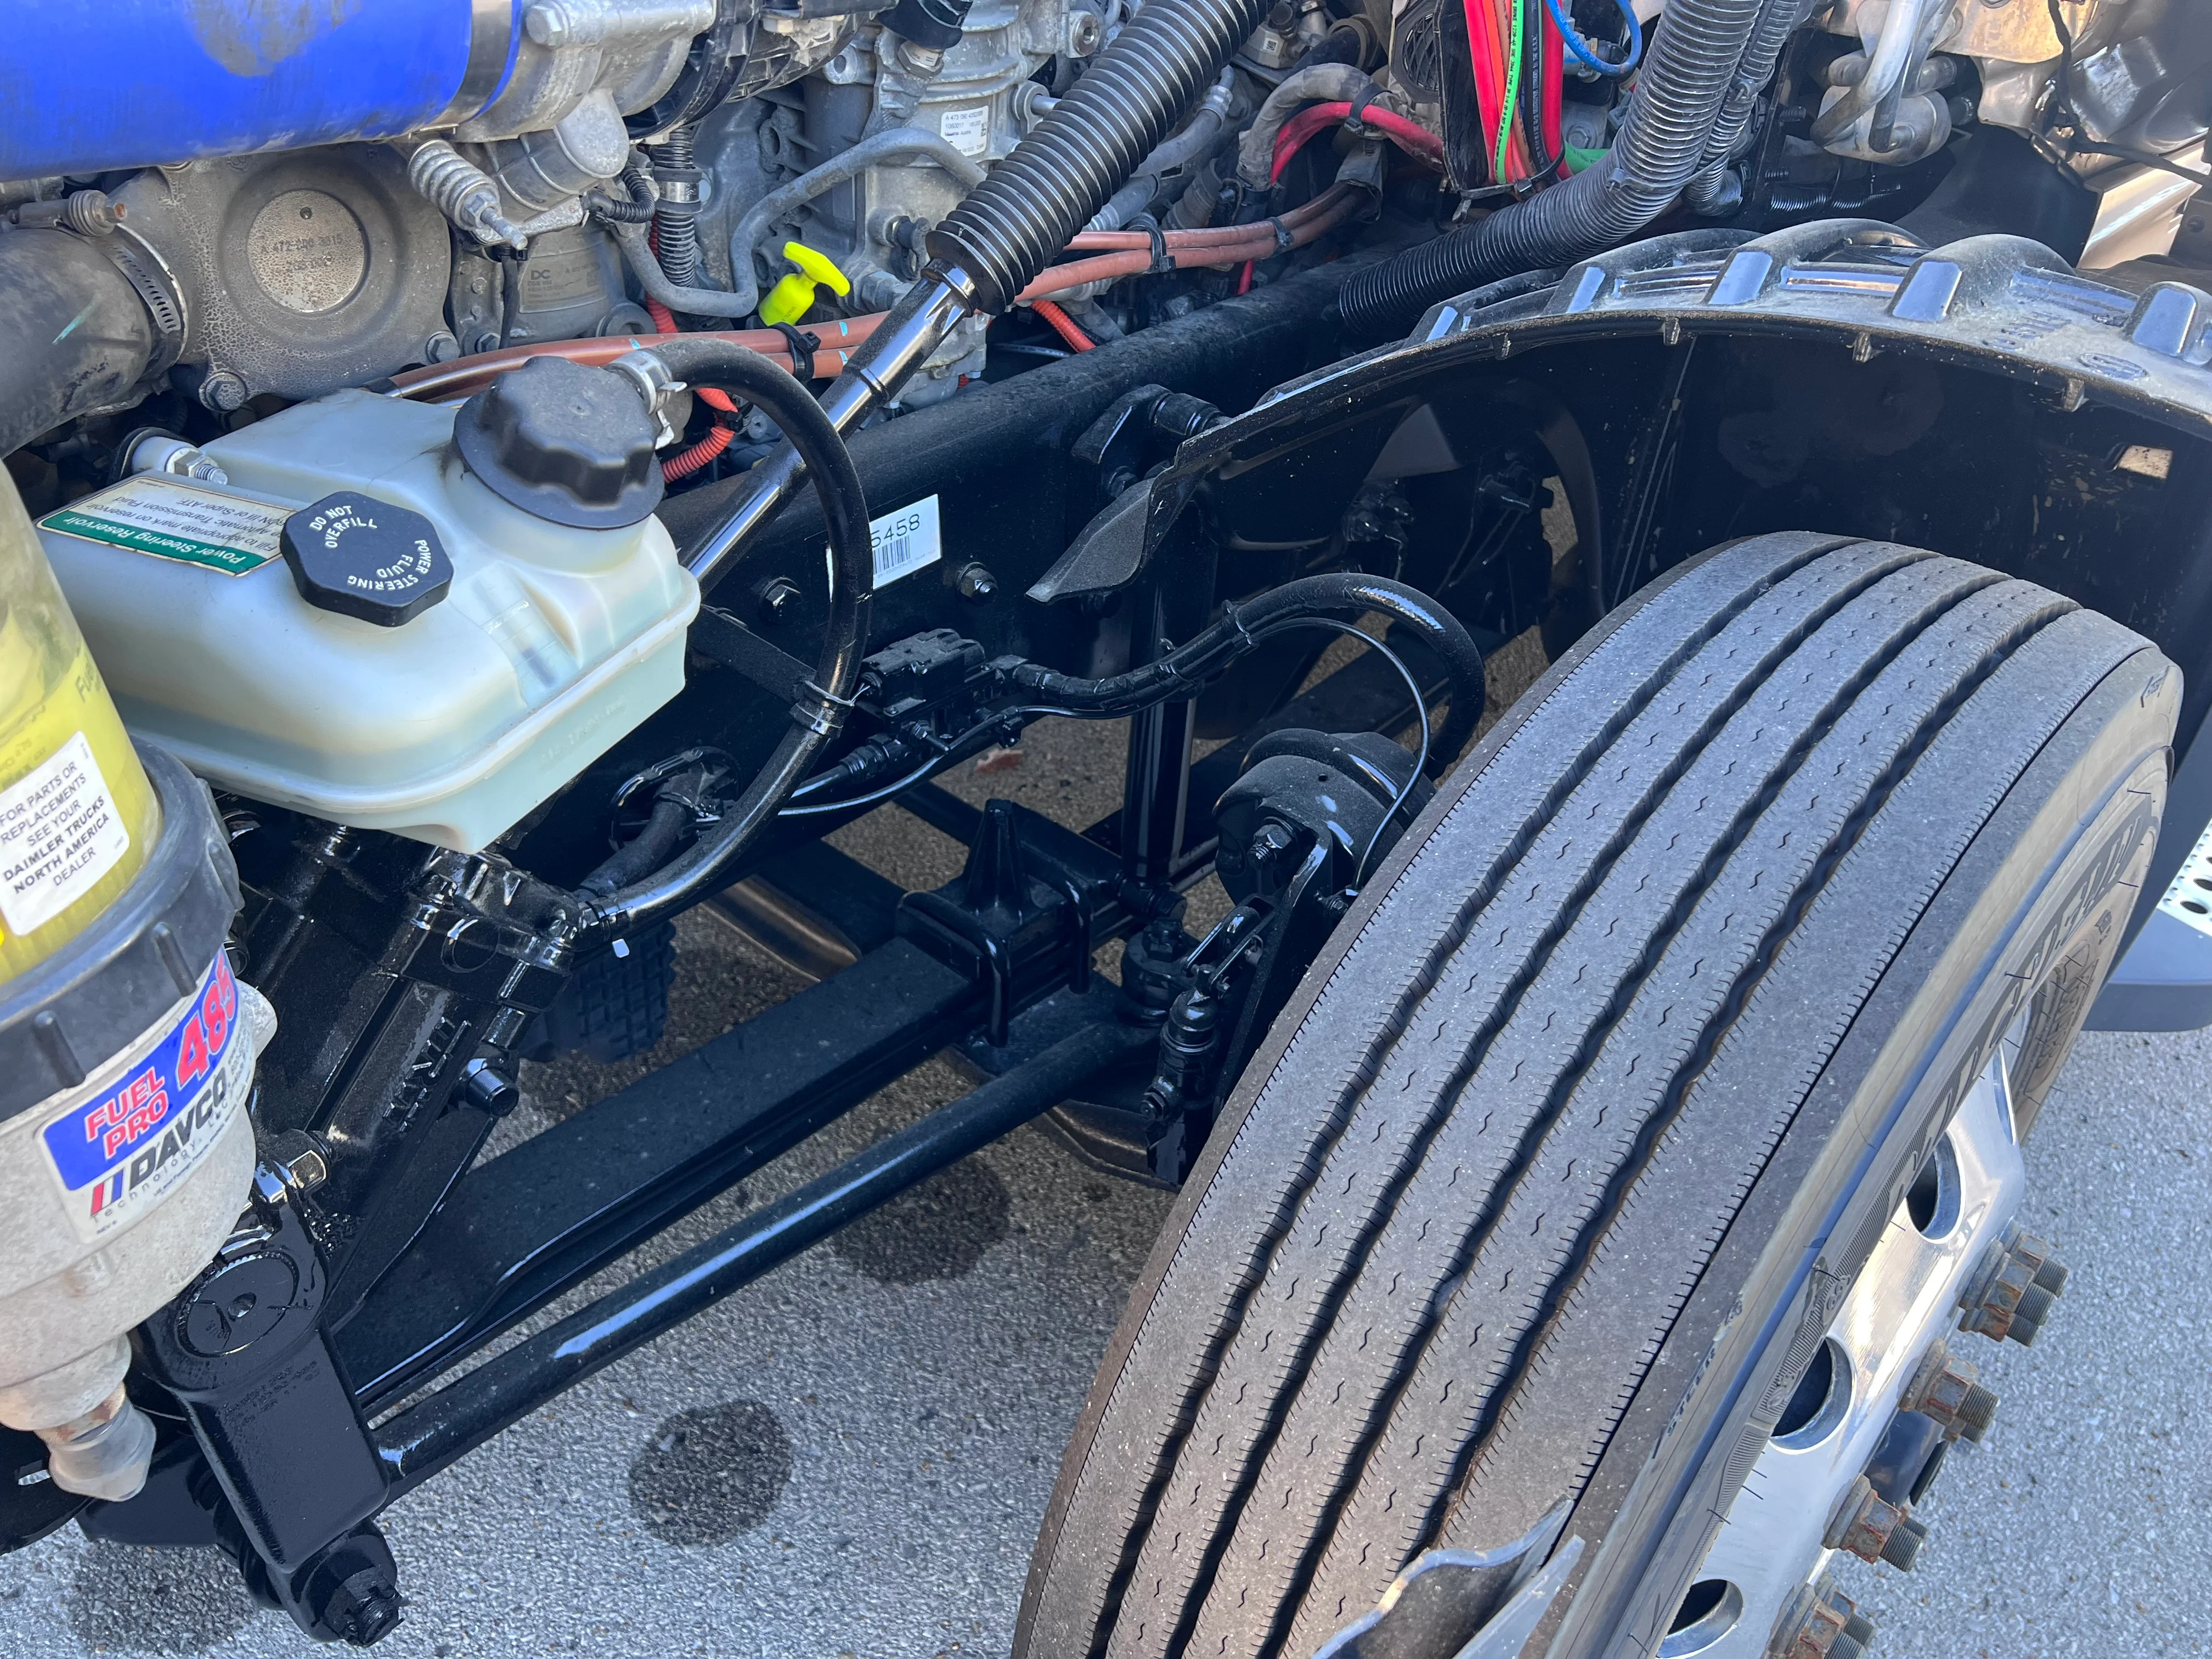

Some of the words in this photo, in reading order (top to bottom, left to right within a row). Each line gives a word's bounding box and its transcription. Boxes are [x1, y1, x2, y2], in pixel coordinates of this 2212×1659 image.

[531, 269, 551, 280] DC
[112, 496, 144, 507] Fluid
[143, 501, 214, 523] Transmission
[201, 503, 235, 515] Super
[63, 517, 136, 538] Reservoir
[151, 518, 182, 528] mark
[214, 519, 269, 535] Automatic
[308, 516, 327, 532] DO
[324, 505, 353, 520] NOT
[133, 531, 198, 553] Steering
[181, 525, 246, 541] appropriate
[324, 517, 379, 549] OVERFILL
[195, 548, 247, 565] Power
[257, 543, 278, 551] Fill
[413, 539, 432, 575] POWER
[376, 554, 414, 579] FLUID
[347, 574, 419, 591] STEERING
[0, 803, 27, 826] FOR
[27, 775, 63, 809] PARTS
[63, 760, 78, 778] OR
[1, 773, 87, 845] REPLACEMENTS
[26, 823, 52, 847] SEE
[50, 799, 82, 828] YOUR
[4, 833, 65, 882] DAIMLER
[65, 795, 105, 837] TRUCKS
[13, 855, 62, 895] NORTH
[64, 812, 110, 857] AMERICA
[53, 846, 97, 888] DEALER
[1883, 815, 2142, 1228] MICHELIN
[84, 1065, 165, 1143] FUEL
[103, 1090, 168, 1161] PRO
[128, 1066, 228, 1191] DAVCO
[1667, 1347, 1717, 1437] STEER
